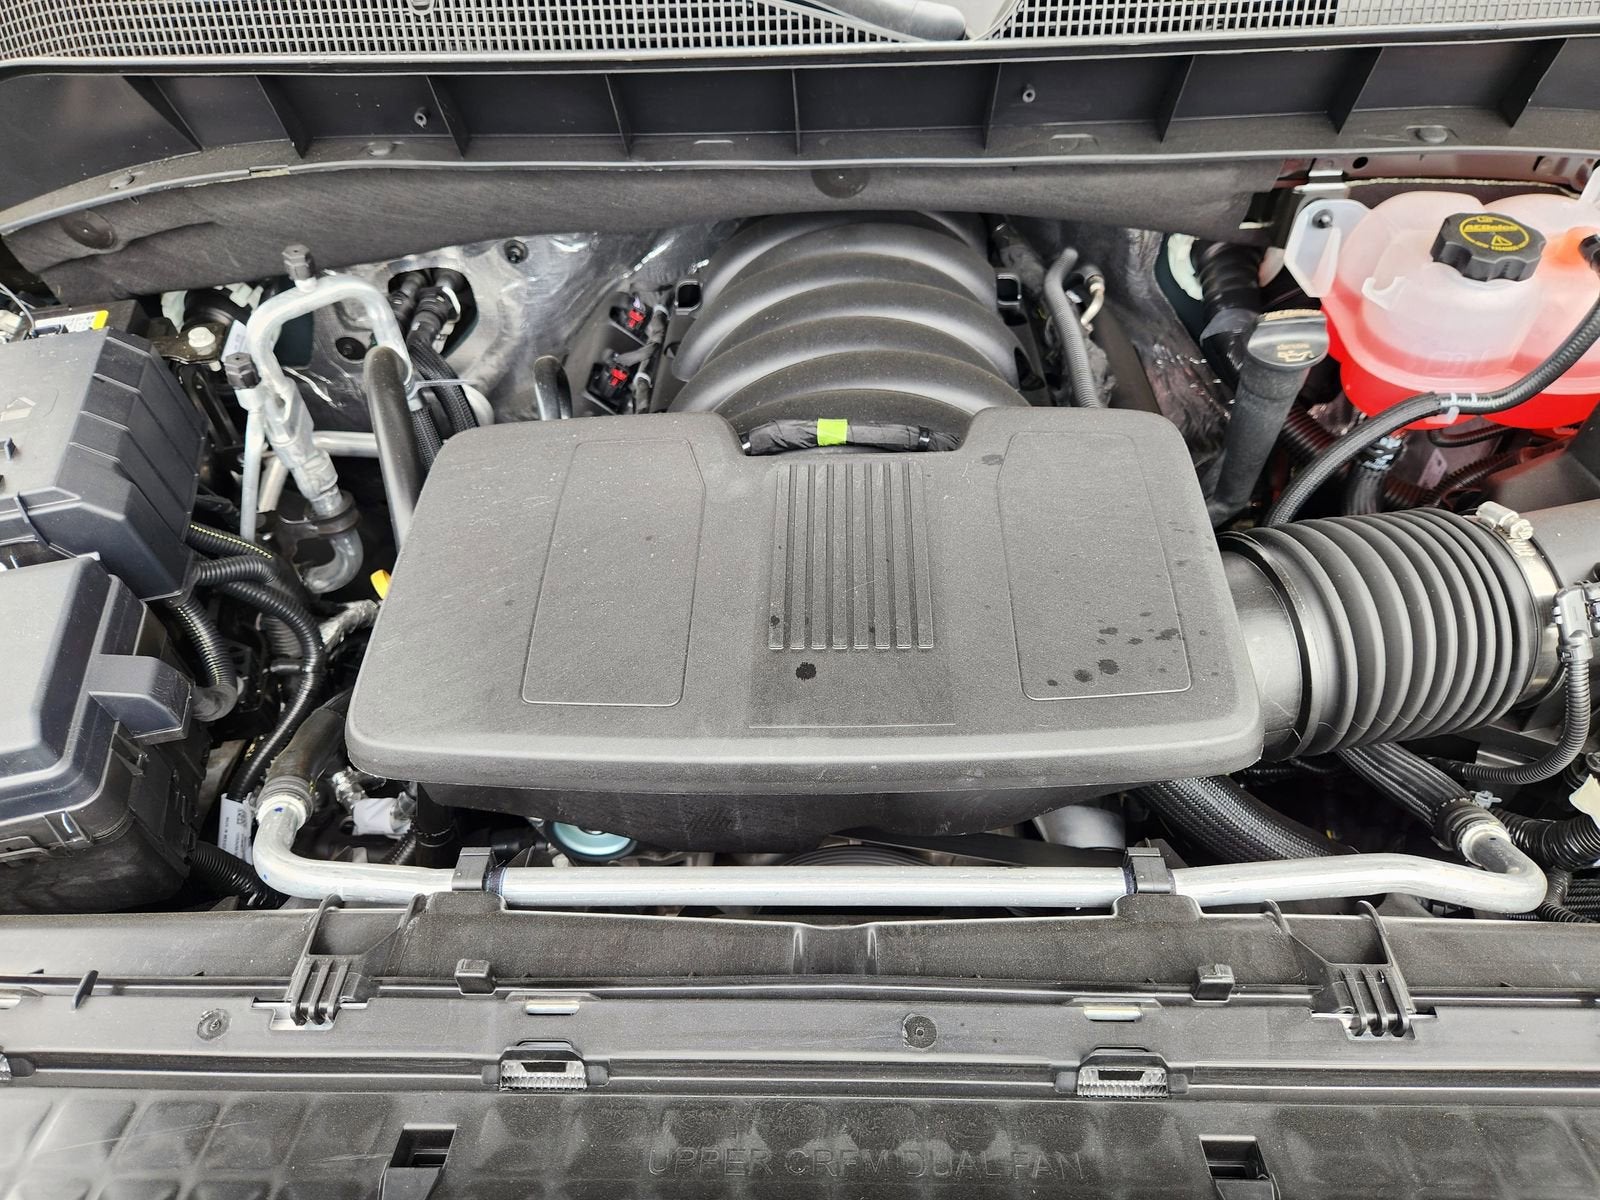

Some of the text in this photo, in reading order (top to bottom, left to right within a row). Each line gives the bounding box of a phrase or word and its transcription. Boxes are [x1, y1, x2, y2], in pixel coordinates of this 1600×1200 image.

[648, 1146, 1085, 1180] UPPER CRFM DUAL FAN
